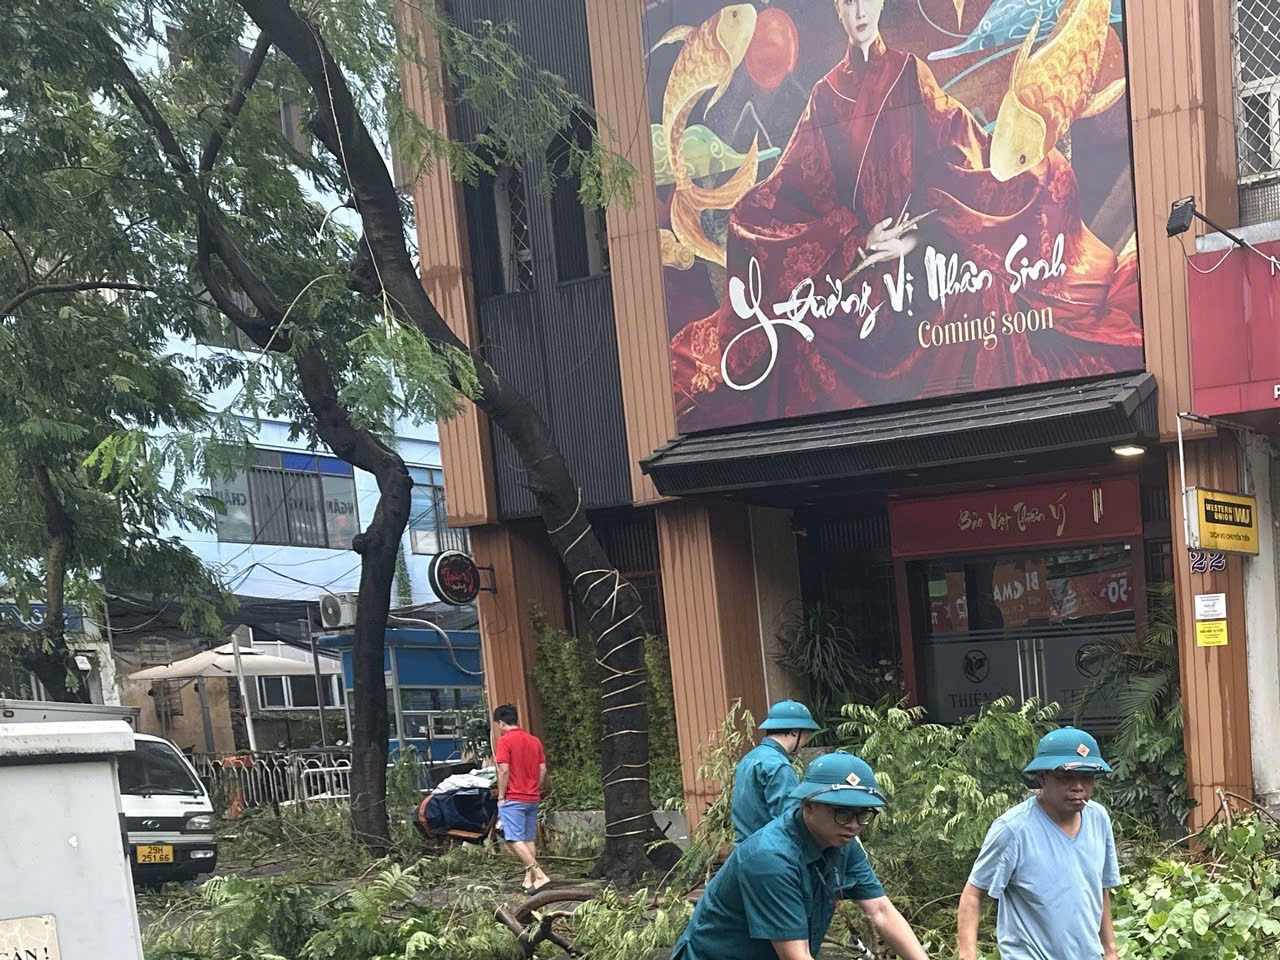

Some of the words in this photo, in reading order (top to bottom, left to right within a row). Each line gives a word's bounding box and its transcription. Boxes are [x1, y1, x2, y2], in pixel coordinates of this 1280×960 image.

[883, 249, 914, 316] Vị
[924, 245, 992, 314] Nhân
[1005, 232, 1066, 294] Sinh
[917, 312, 998, 350] Coming
[1001, 306, 1054, 336] soon
[1206, 503, 1233, 513] WESTERN
[1214, 512, 1233, 521] UNION
[1191, 552, 1225, 574] 22
[147, 846, 163, 854] 29H
